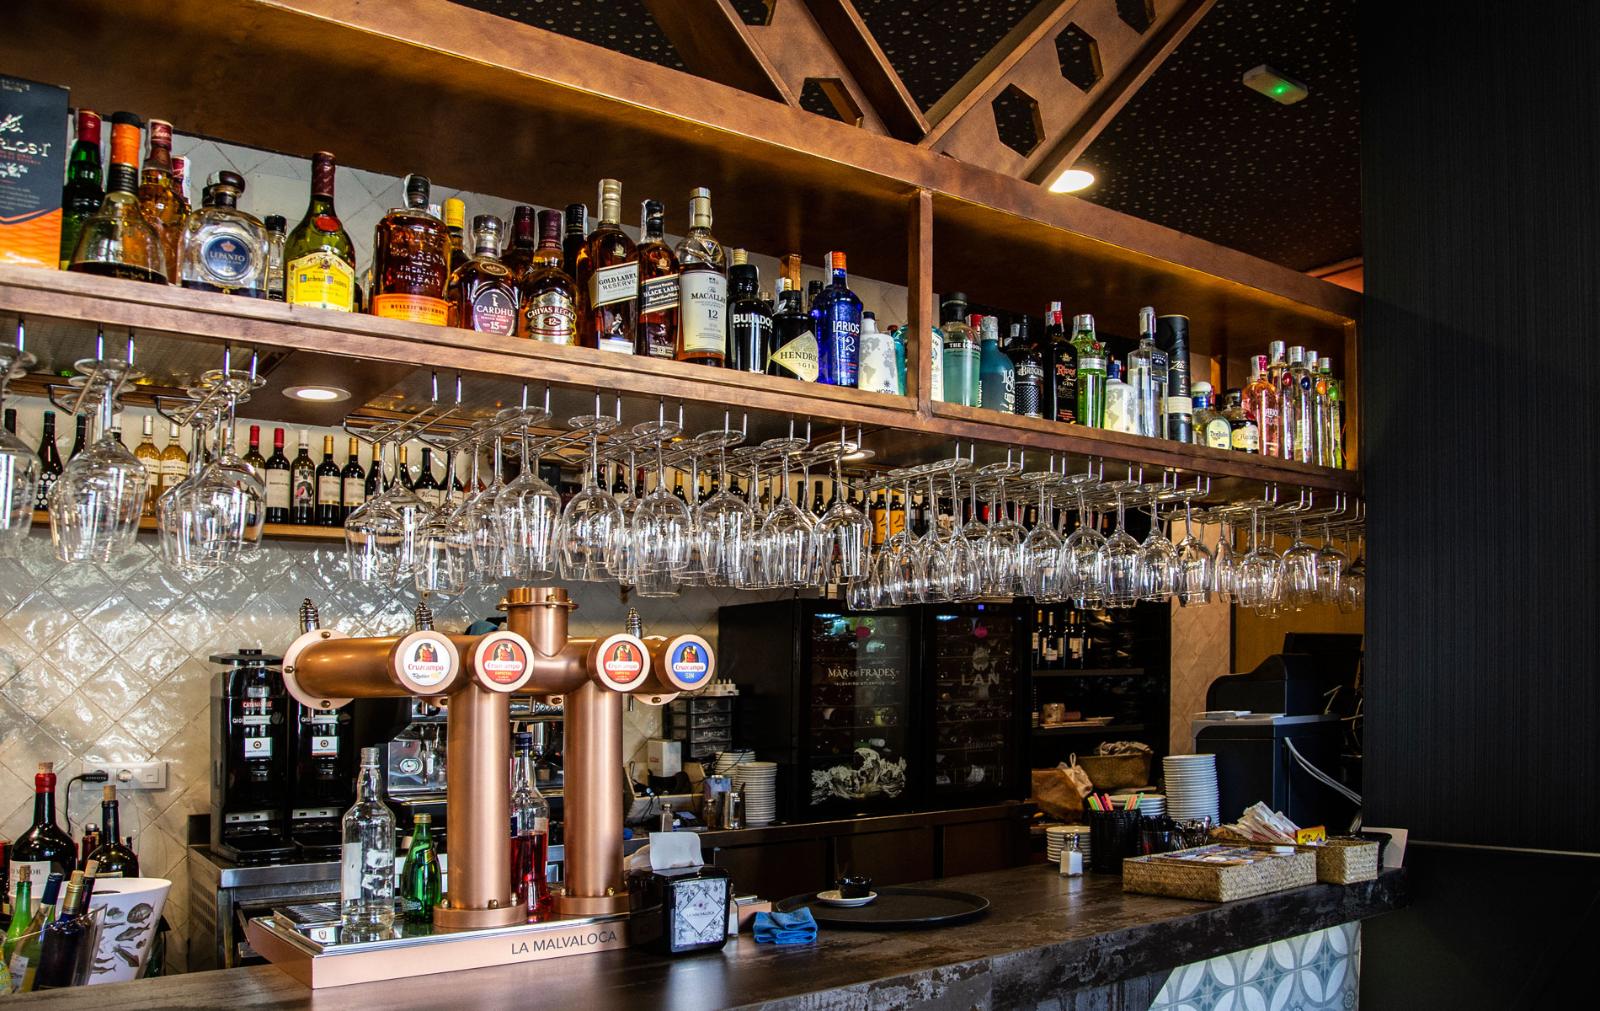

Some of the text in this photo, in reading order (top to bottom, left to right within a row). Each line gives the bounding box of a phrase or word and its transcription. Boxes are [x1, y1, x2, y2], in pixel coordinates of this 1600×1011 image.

[209, 251, 246, 263] LEPANTO
[643, 289, 662, 298] BLACK
[476, 305, 513, 317] CARDHU
[527, 306, 576, 321] CHIVAS REGAL
[708, 309, 718, 319] 12
[489, 320, 500, 331] 15
[548, 317, 557, 326] 12
[832, 320, 860, 334] LARIOS
[840, 336, 856, 352] 12
[407, 663, 444, 672] Cruzcampo
[675, 663, 704, 672] Cruzcampo
[511, 931, 617, 955] LA MALVALOCA
